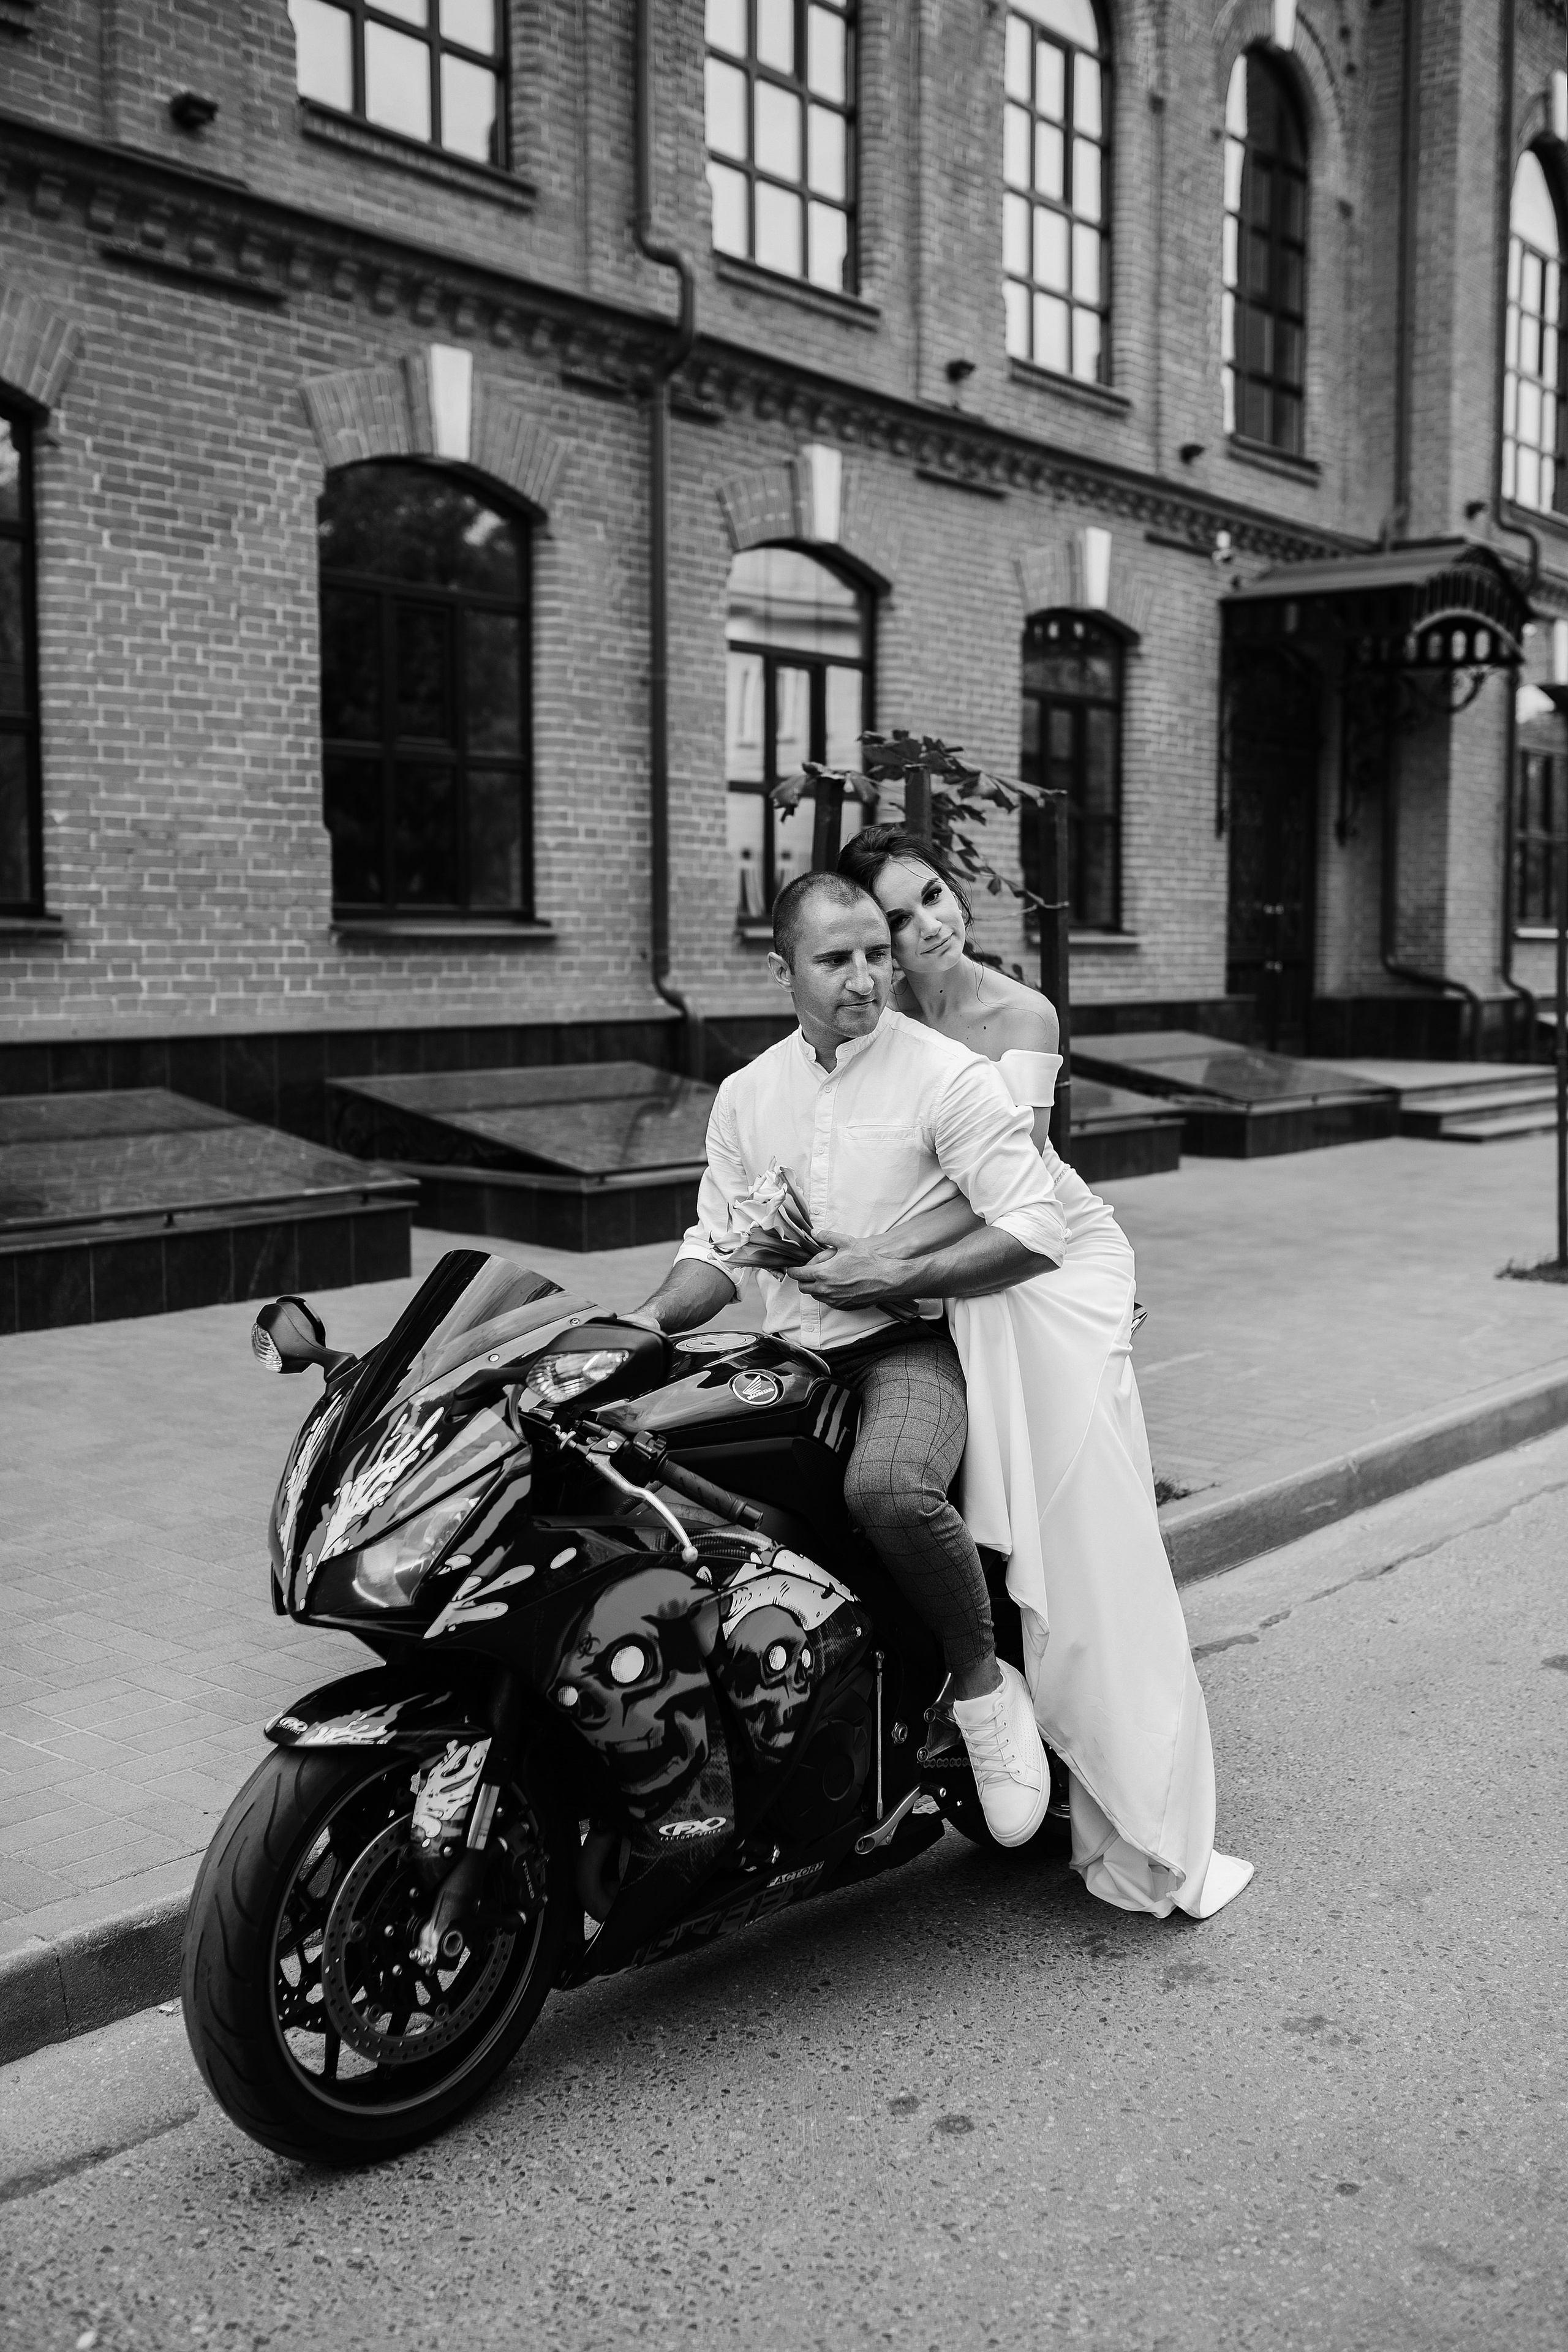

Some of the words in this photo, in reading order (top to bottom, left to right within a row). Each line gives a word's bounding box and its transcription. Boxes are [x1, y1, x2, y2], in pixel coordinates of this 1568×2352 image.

[747, 1387, 774, 1401] HONDA
[522, 1860, 535, 1899] TOKICO
[767, 1861, 824, 1887] FACTORY
